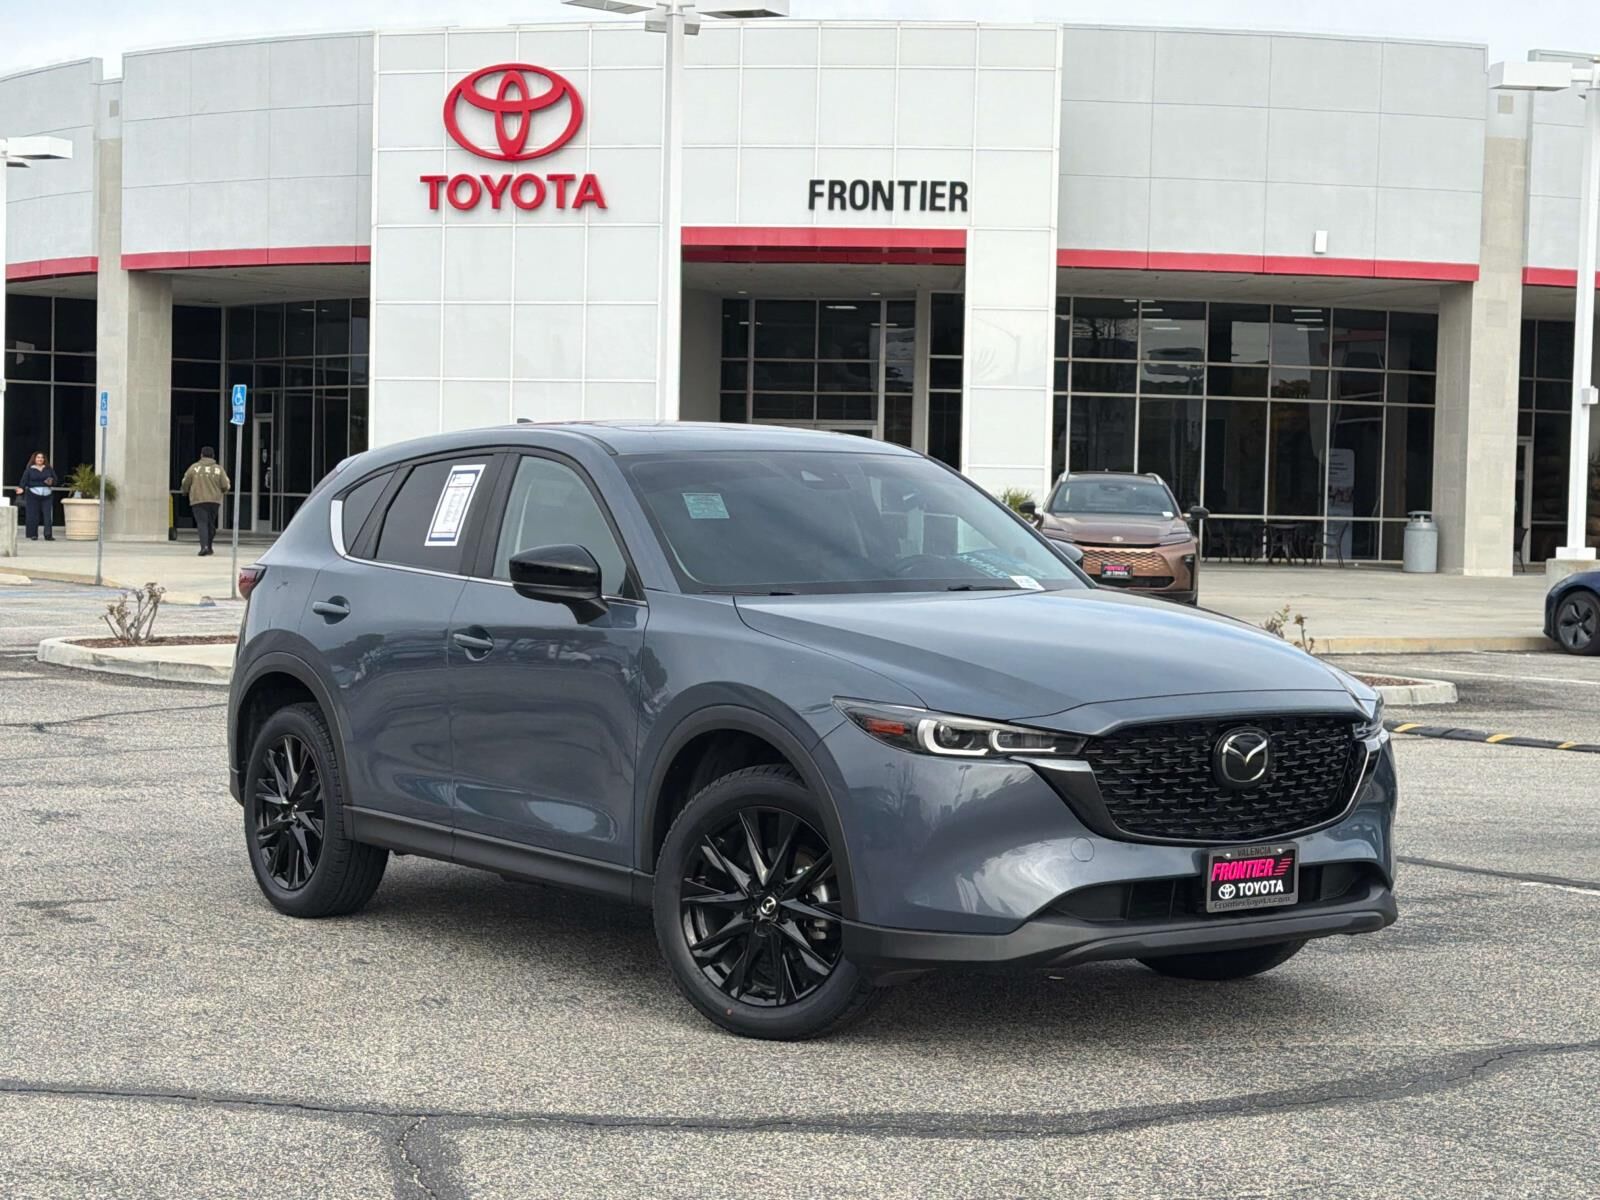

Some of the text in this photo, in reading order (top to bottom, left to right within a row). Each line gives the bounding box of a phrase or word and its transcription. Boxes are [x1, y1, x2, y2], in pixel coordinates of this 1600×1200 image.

[420, 173, 608, 211] TOYOTA
[808, 179, 968, 212] FRONTIER
[1237, 847, 1271, 857] VALENCIA
[1211, 858, 1275, 882] FRONTIER
[1238, 880, 1284, 896] TOYOTA
